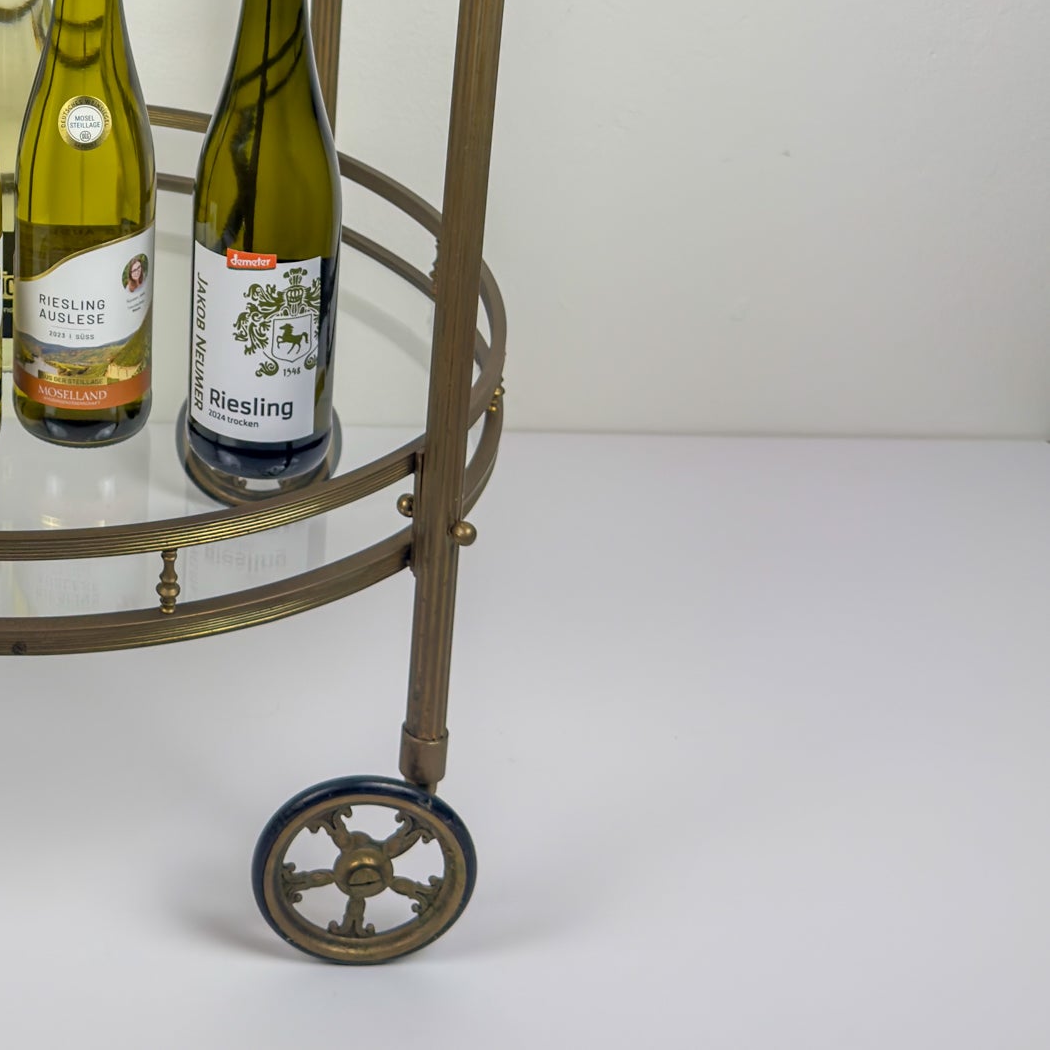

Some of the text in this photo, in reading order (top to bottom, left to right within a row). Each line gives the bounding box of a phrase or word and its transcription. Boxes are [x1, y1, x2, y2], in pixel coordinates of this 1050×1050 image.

[230, 253, 271, 267] demeter
[39, 293, 106, 310] RIESLING
[39, 308, 105, 325] AUSLESE
[49, 330, 95, 340] 2023 SÜSS
[194, 271, 209, 411] JAKOB NEUMER
[38, 384, 108, 401] MOSELLAND
[209, 387, 294, 420] Riesling
[208, 409, 260, 428] 2024 trocken
